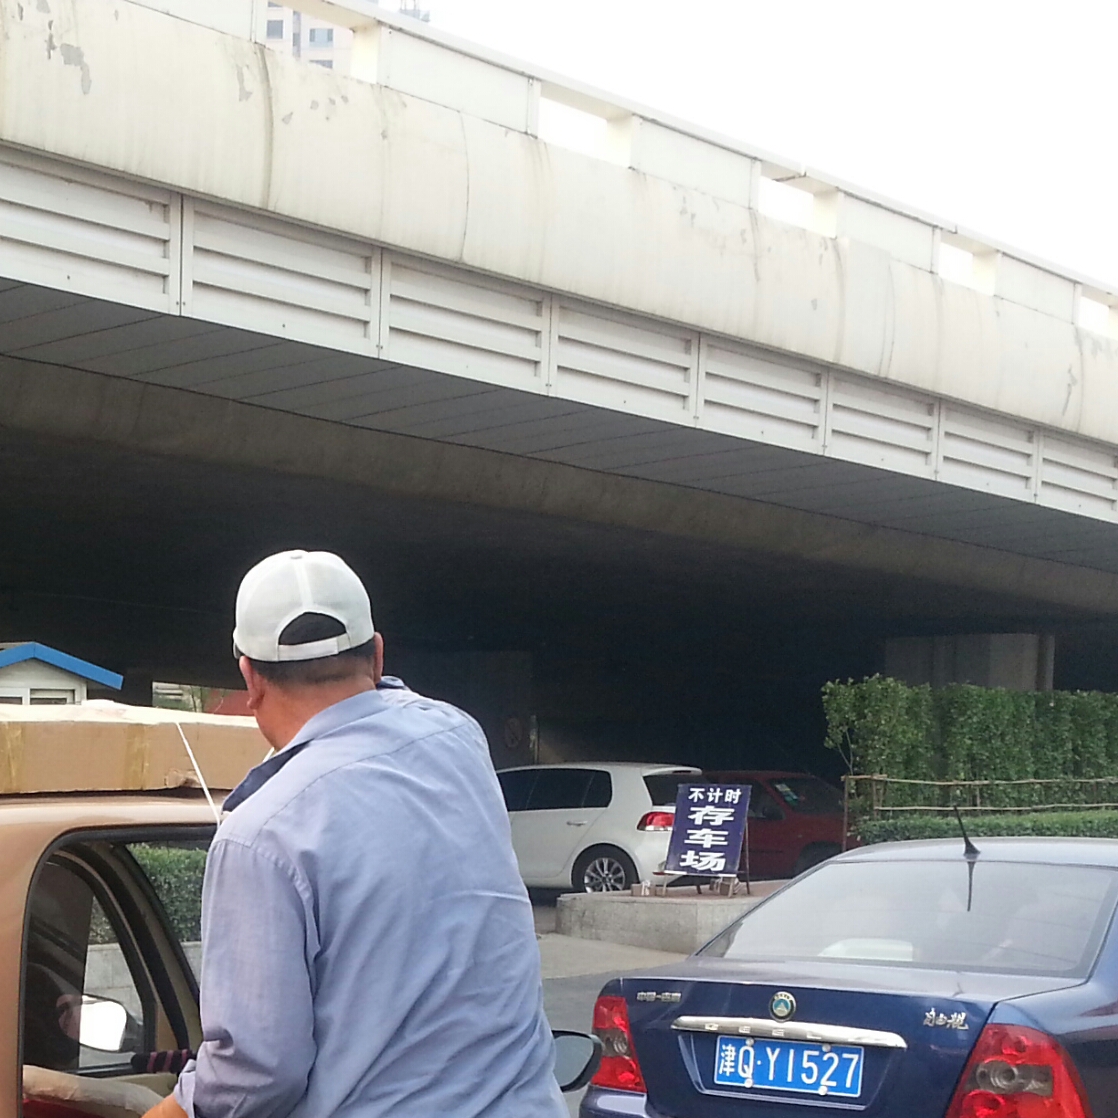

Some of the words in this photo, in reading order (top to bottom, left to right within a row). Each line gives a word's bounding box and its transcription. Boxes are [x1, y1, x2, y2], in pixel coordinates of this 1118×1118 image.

[687, 787, 742, 804] 不计时
[679, 805, 736, 872] 存车场
